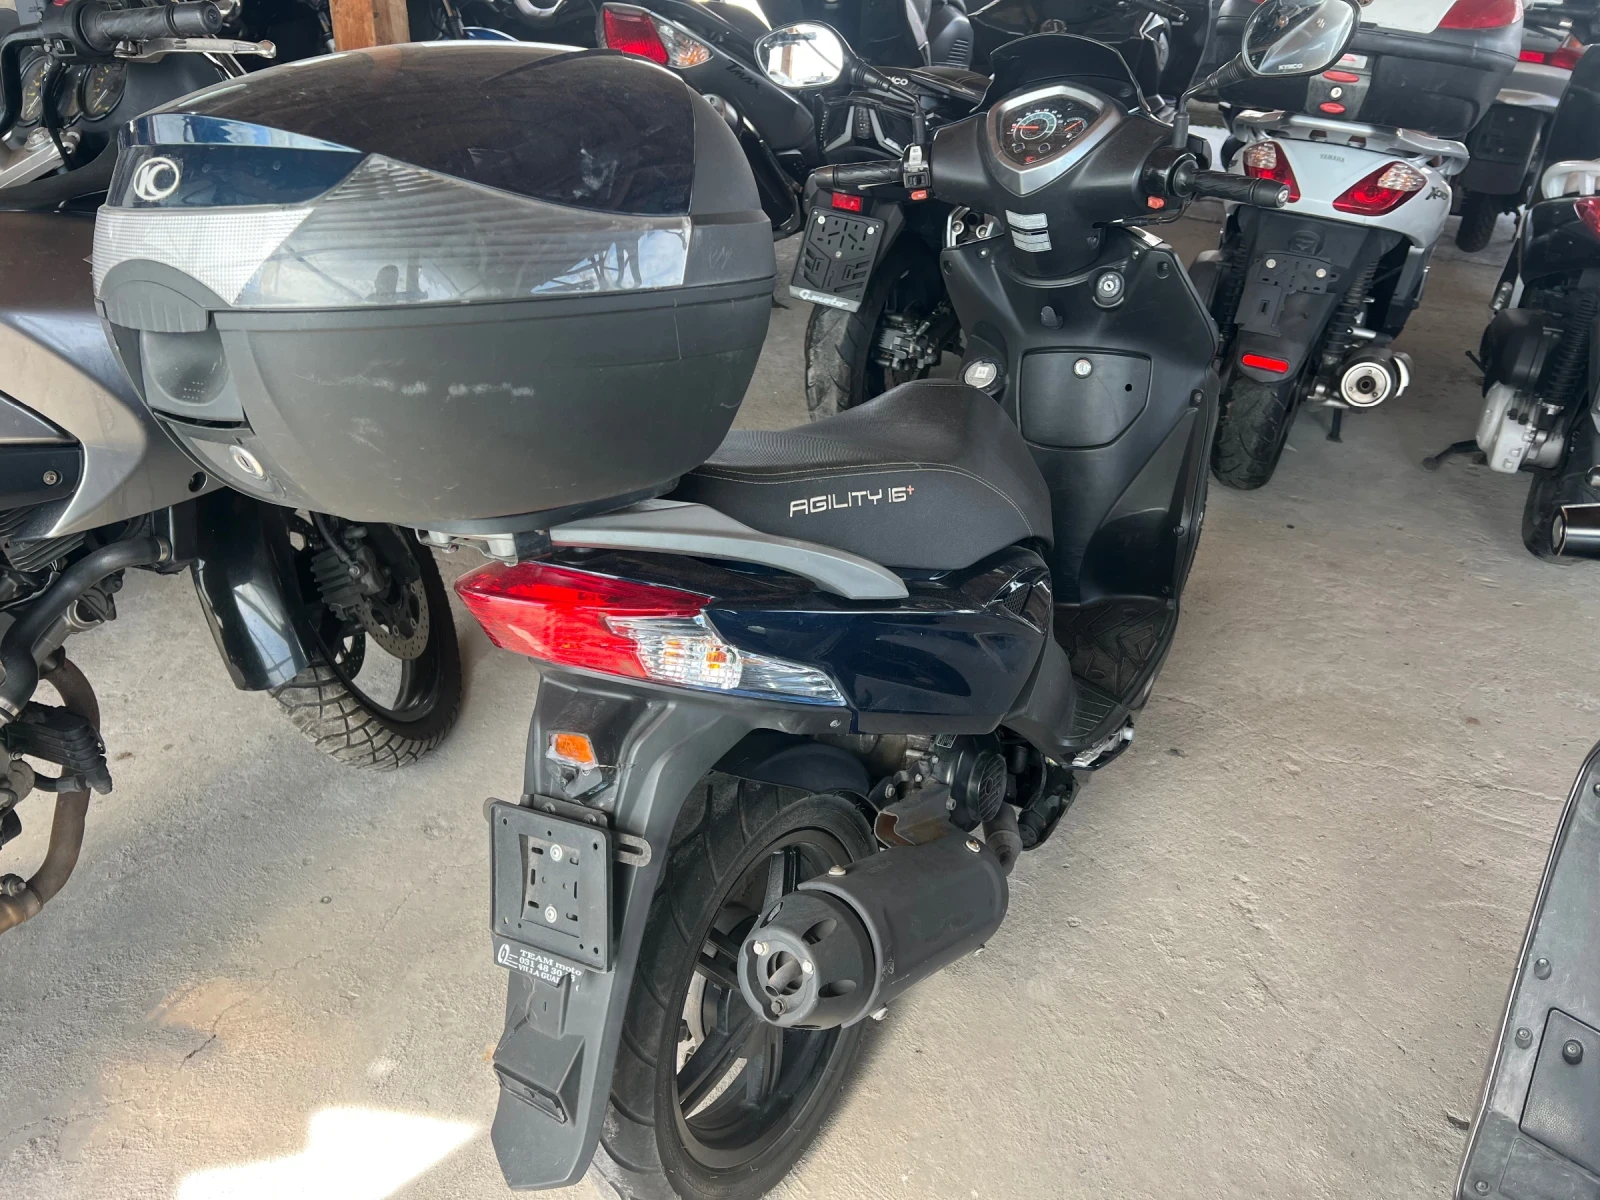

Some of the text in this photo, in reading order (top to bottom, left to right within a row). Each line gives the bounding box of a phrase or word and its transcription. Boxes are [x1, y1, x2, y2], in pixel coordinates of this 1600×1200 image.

[789, 488, 882, 518] AGILITY
[519, 949, 582, 976] TEAM moto
[519, 956, 535, 968] 031
[537, 963, 549, 973] 48
[550, 967, 563, 977] 30
